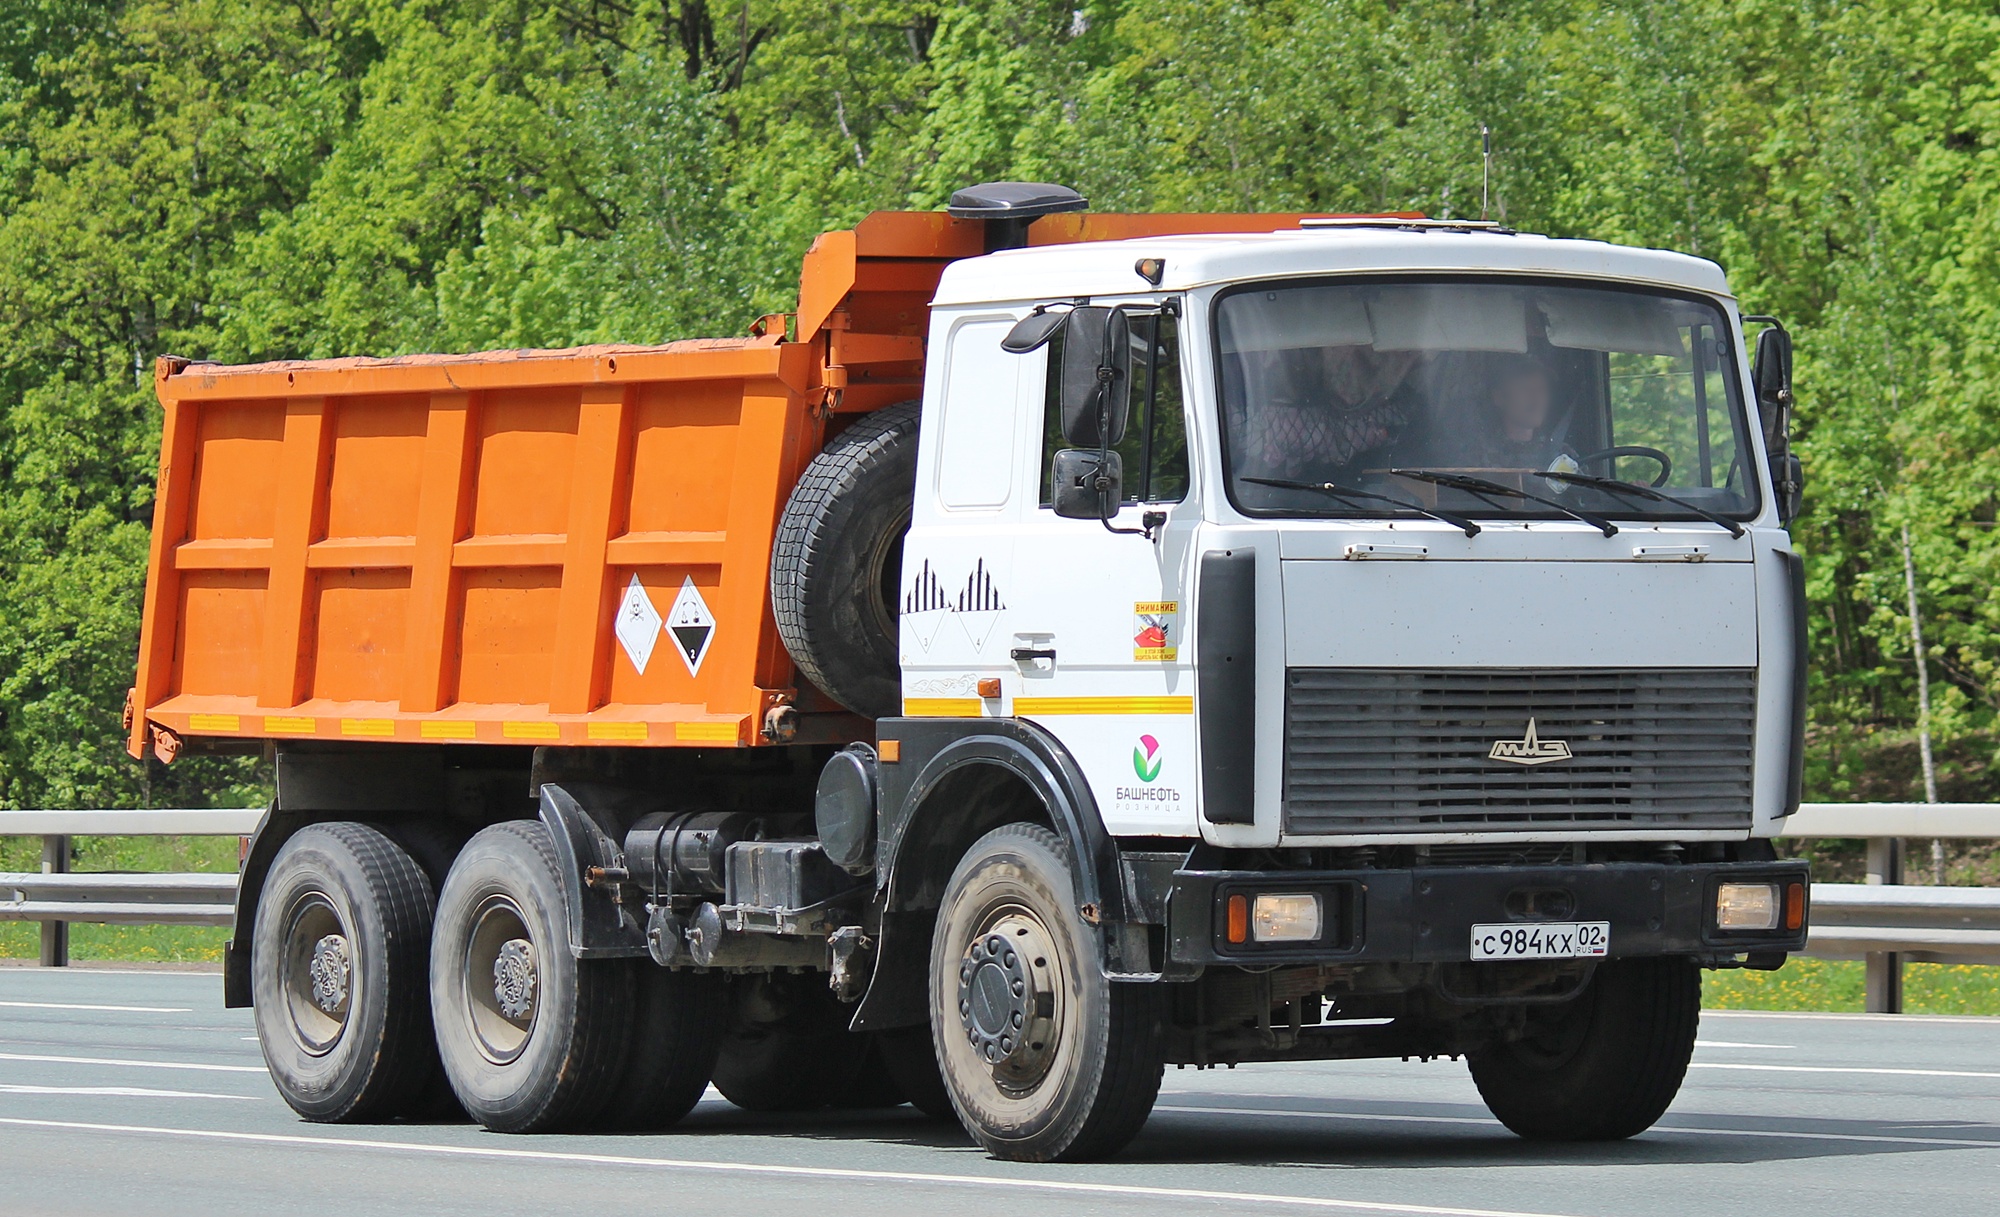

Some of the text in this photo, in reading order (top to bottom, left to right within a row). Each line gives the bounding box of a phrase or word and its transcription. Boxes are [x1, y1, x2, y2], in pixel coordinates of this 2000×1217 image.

[1136, 603, 1176, 612] ВНИМАНИЕ!
[690, 648, 696, 659] 2
[1116, 787, 1181, 802] БАШНЕФТЬ
[1115, 803, 1181, 812] РОЗНИЦА
[1578, 926, 1600, 946] 02
[1576, 946, 1592, 954] RUS
